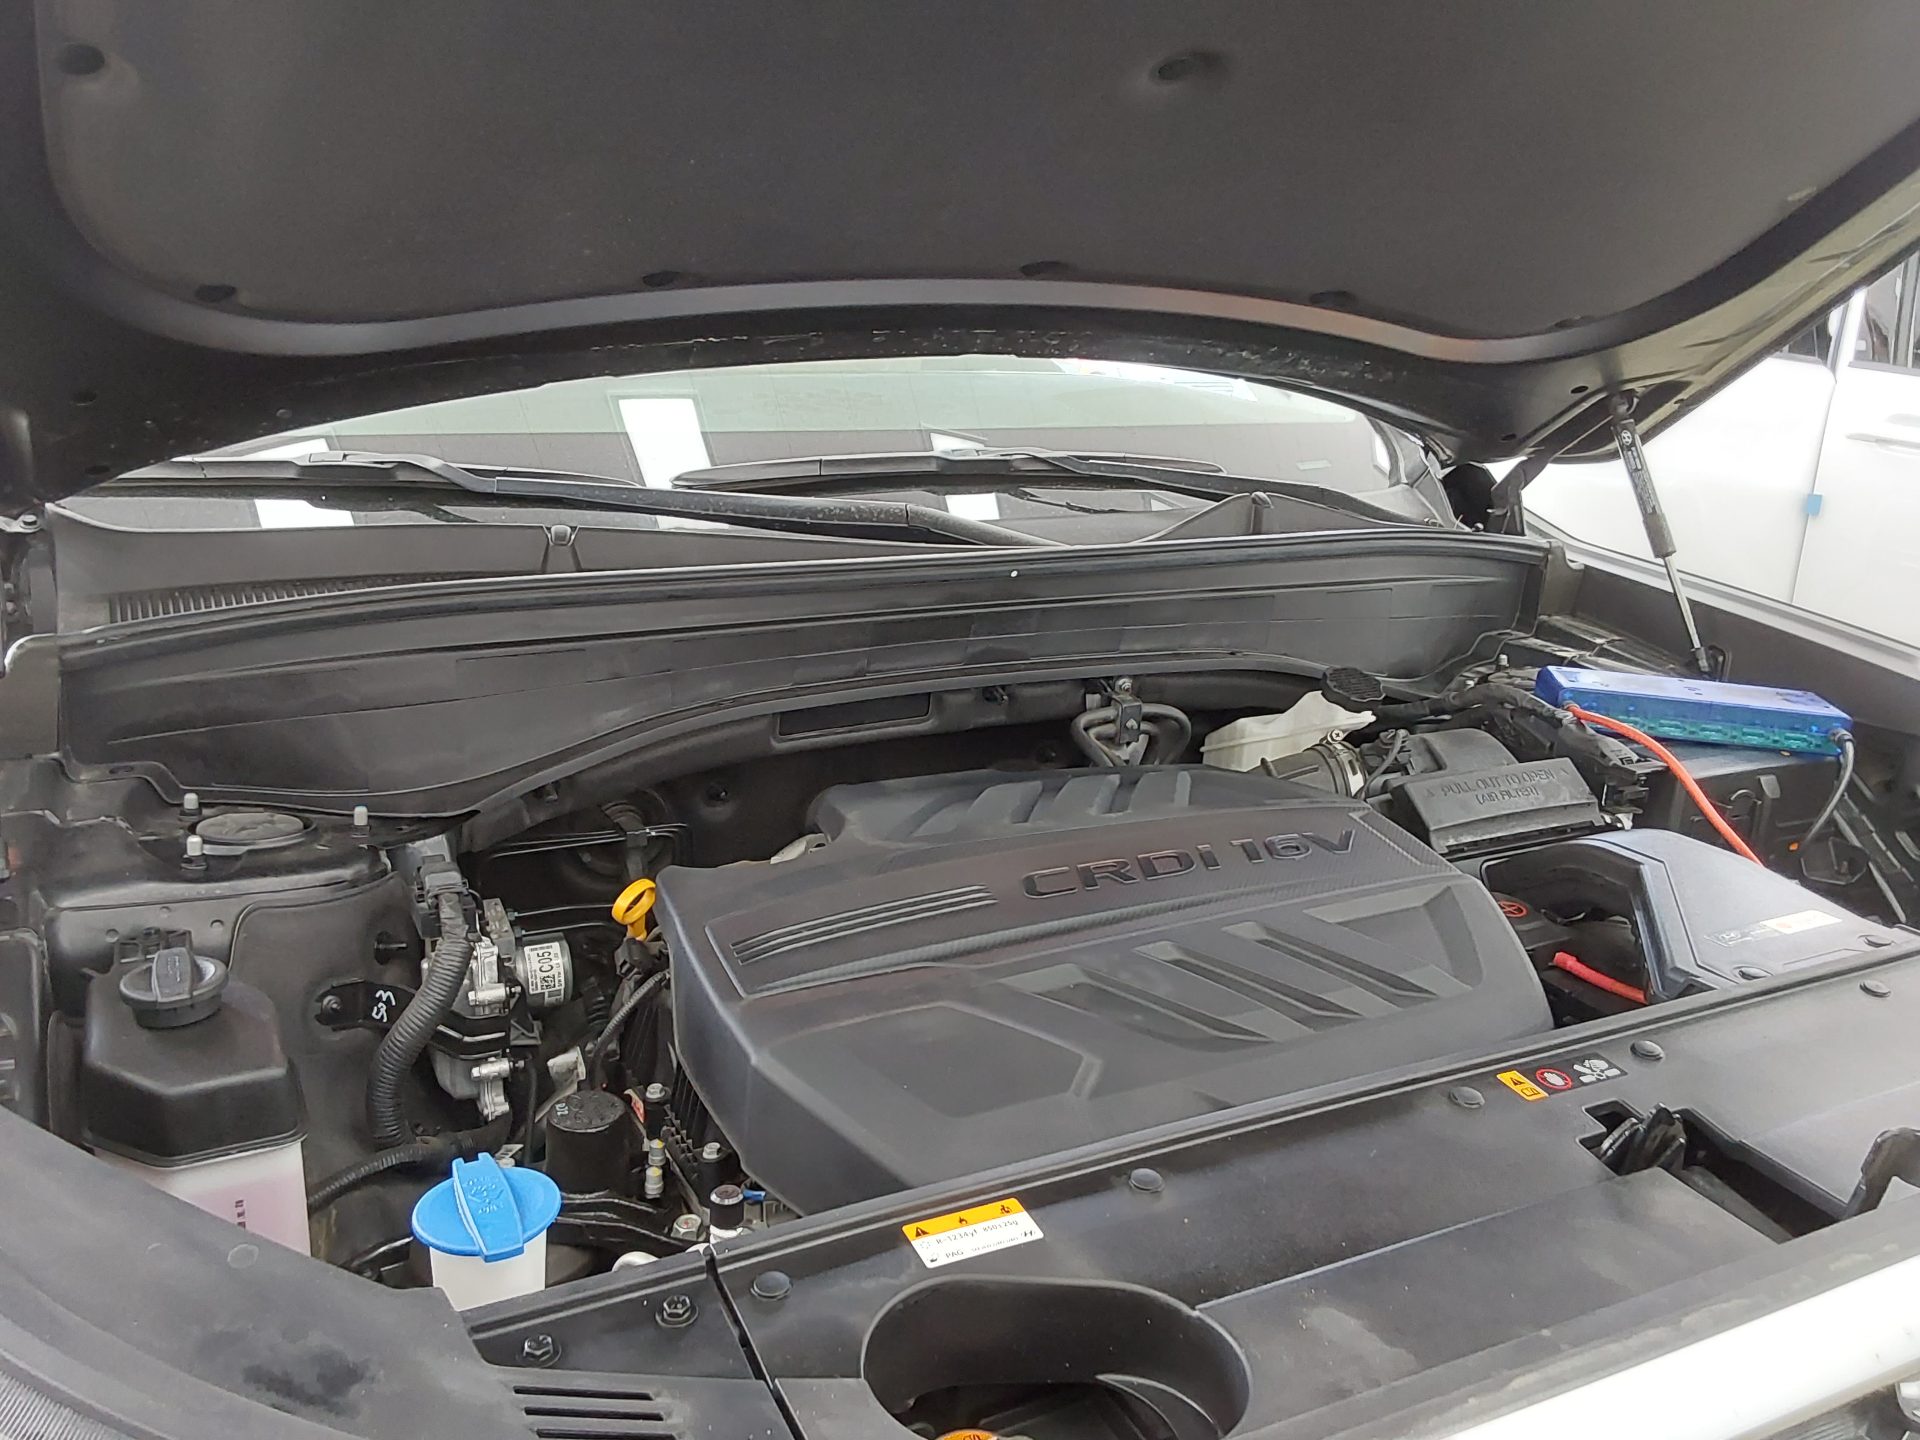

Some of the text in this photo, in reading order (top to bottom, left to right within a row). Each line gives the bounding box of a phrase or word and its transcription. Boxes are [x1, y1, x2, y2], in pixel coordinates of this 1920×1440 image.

[1441, 769, 1556, 797] PULL OUT TO OPEN
[1231, 829, 1355, 864] 16V
[945, 1249, 964, 1260] PAG
